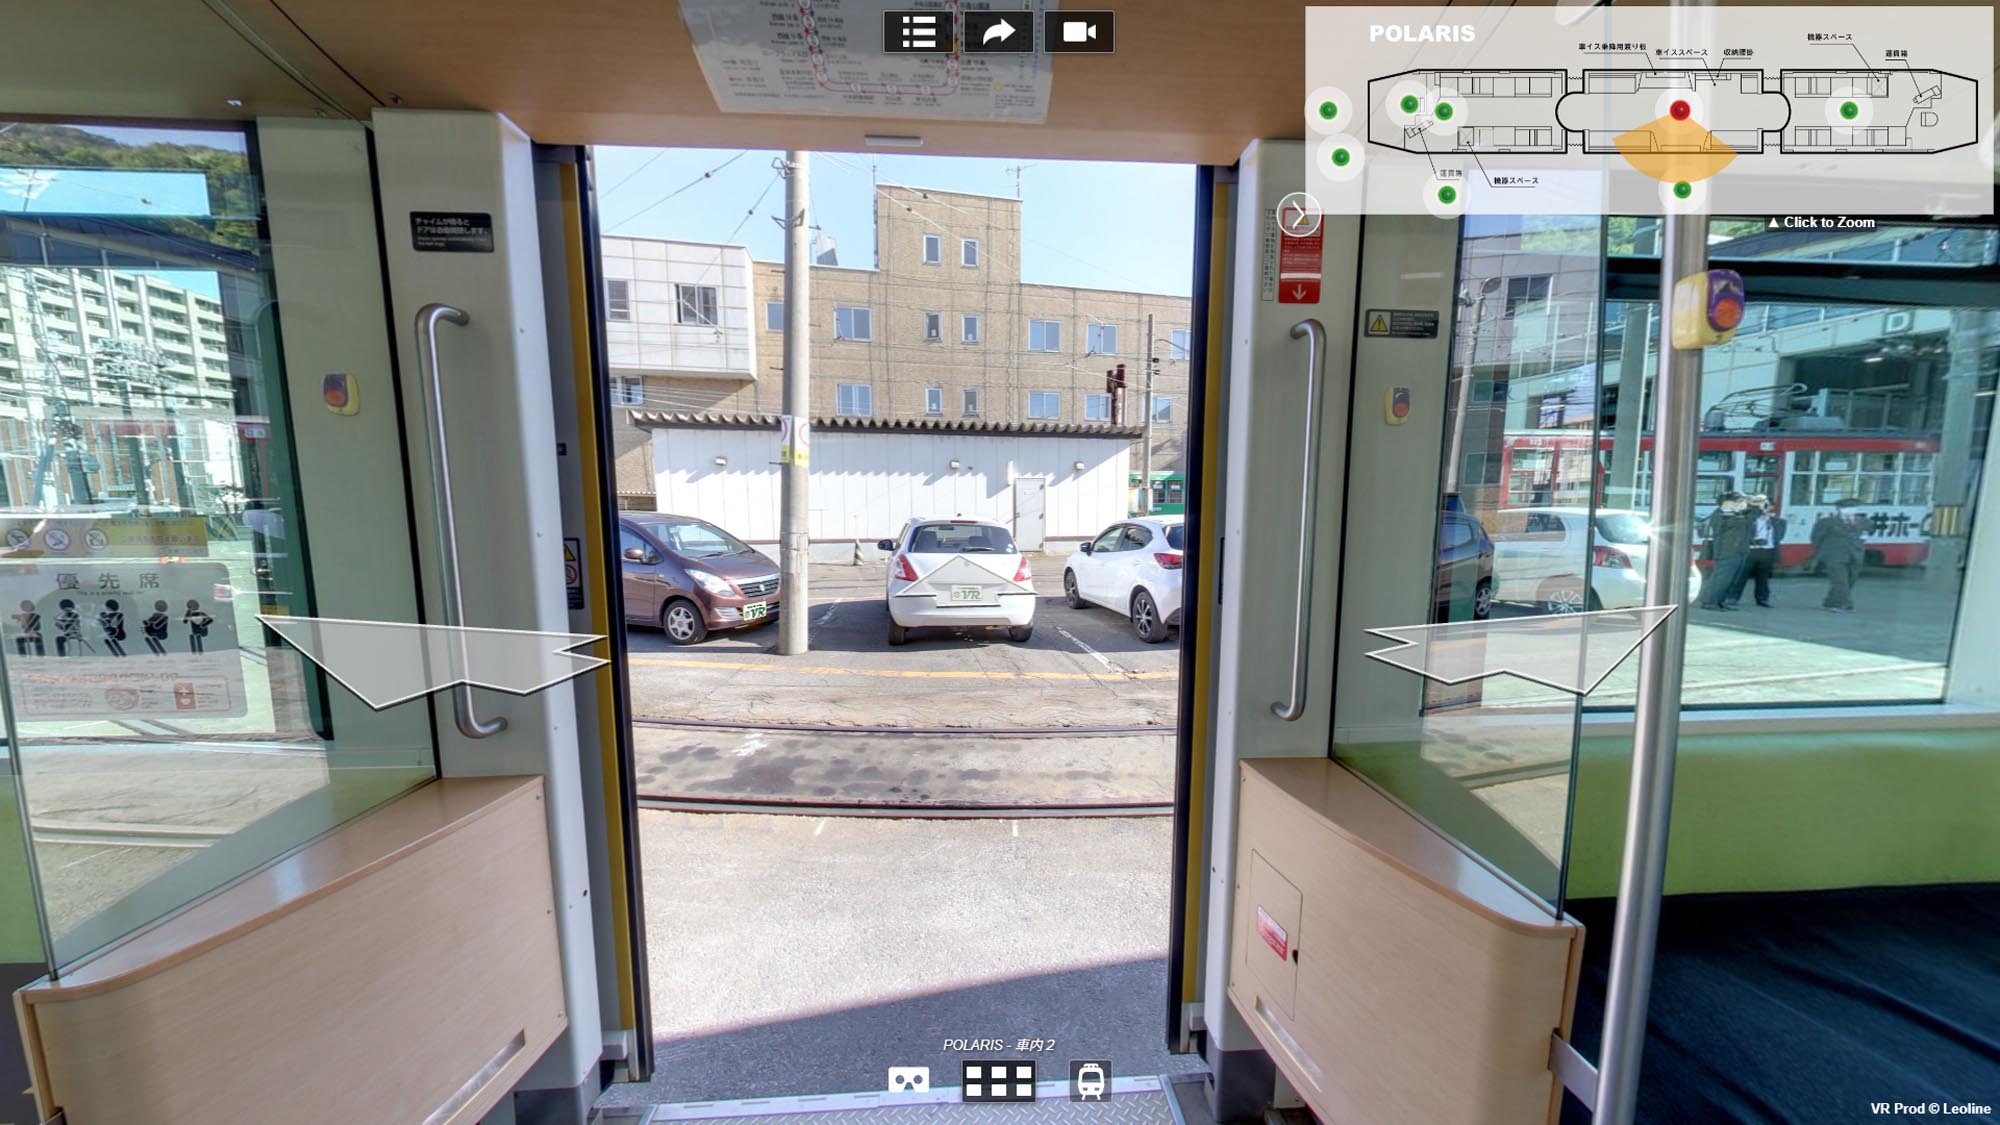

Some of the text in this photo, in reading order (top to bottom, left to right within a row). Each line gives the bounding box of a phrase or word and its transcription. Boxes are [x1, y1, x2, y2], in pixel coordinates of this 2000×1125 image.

[1885, 311, 1911, 333] D
[56, 572, 161, 590] 優先席
[961, 590, 982, 600] VR
[750, 606, 766, 618] VR
